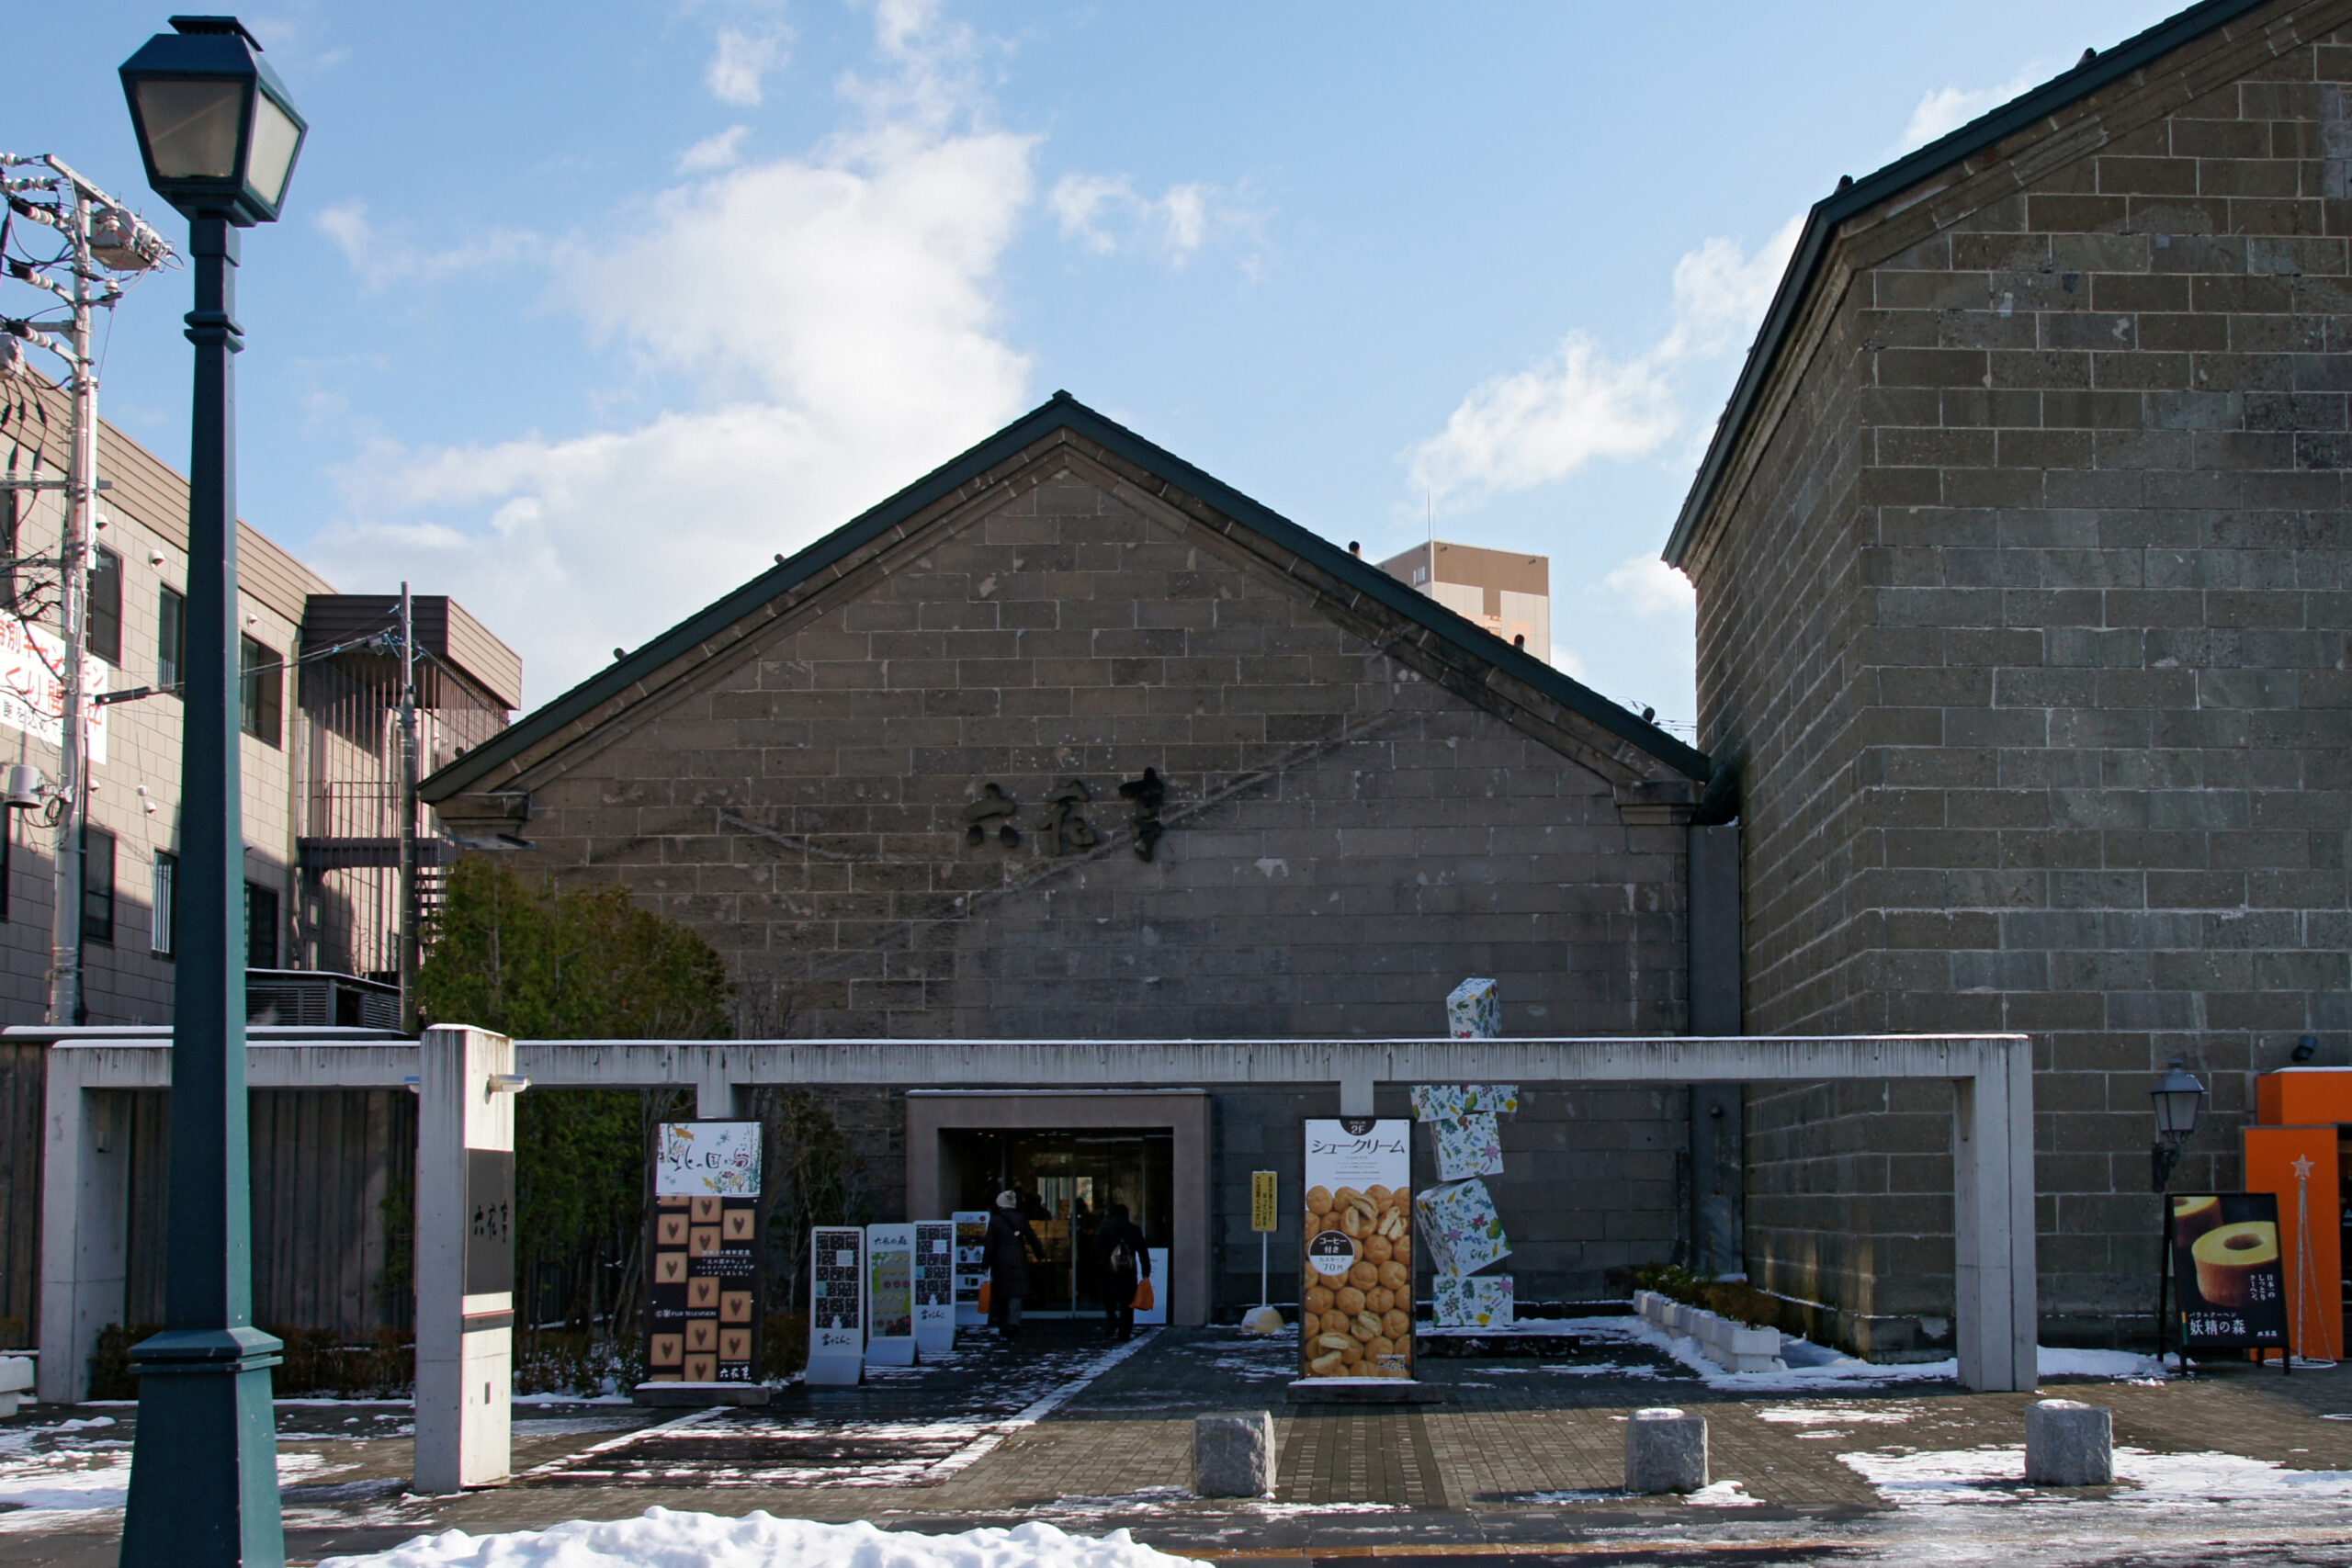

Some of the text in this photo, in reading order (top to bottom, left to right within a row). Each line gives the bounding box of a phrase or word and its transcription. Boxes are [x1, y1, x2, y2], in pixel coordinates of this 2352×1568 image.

[961, 772, 1165, 863] 六花亭
[1351, 1124, 1364, 1134] 2F
[1311, 1138, 1406, 1155] シュークリーム
[473, 1199, 508, 1244] 六花亭
[1324, 1246, 1340, 1254] 付き
[1323, 1263, 1343, 1271] 70円
[2189, 1318, 2246, 1336] 妖精の森
